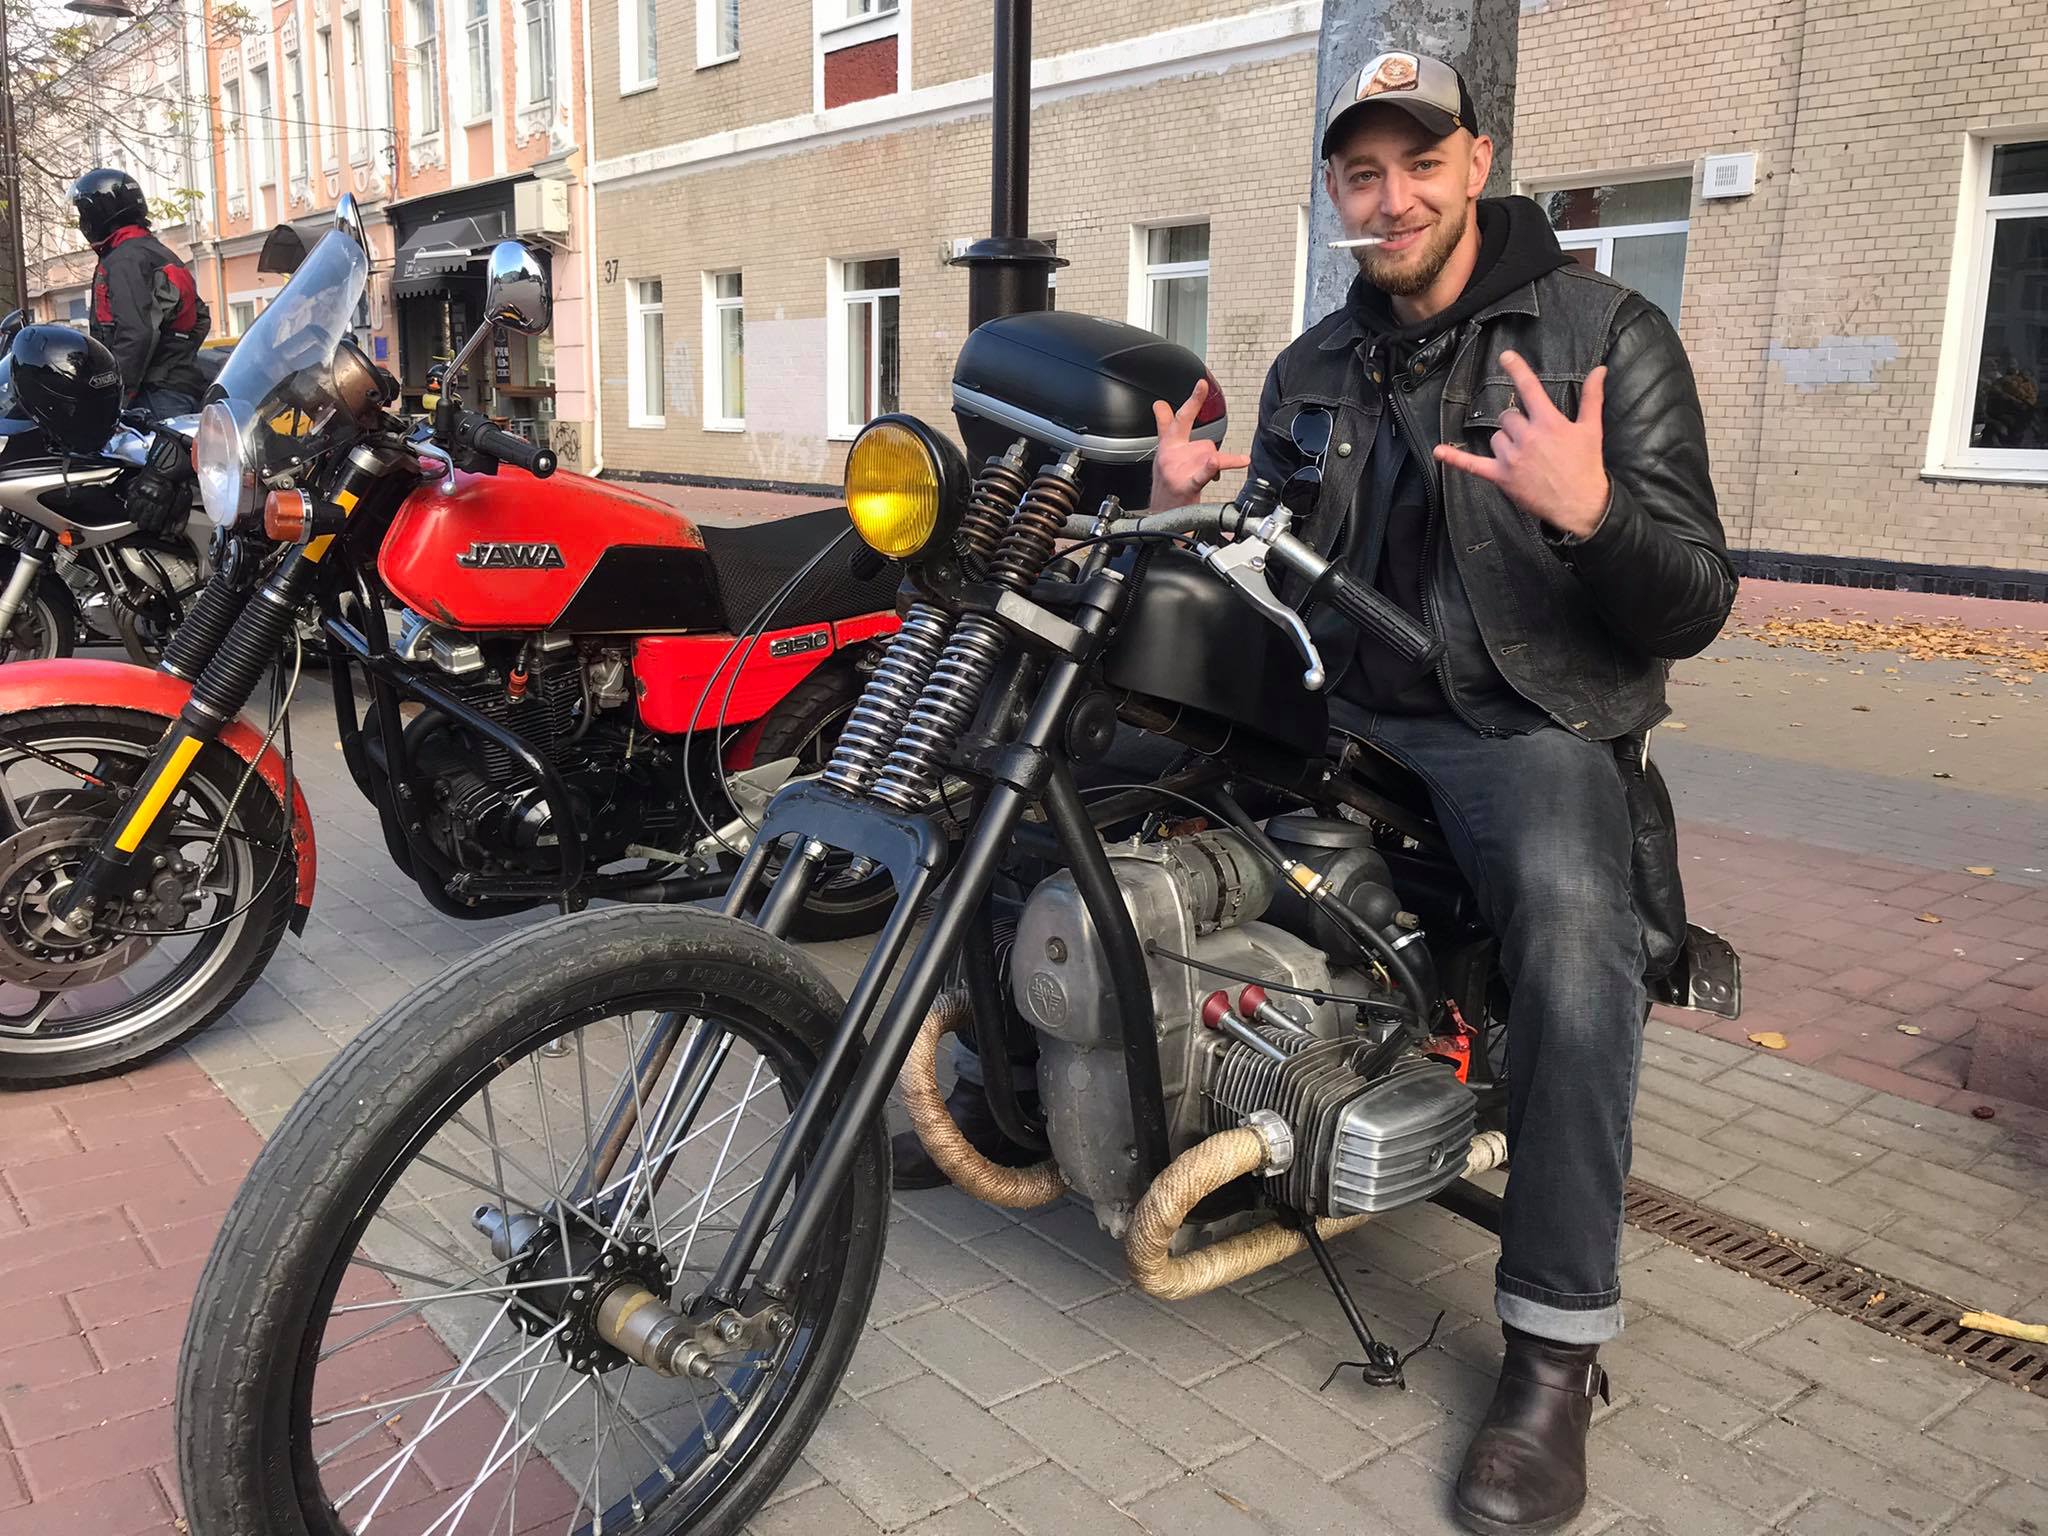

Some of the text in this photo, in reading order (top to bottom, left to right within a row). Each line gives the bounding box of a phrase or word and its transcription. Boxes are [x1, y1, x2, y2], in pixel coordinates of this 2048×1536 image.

[605, 259, 619, 284] 37
[456, 542, 567, 570] JAWA
[770, 631, 828, 657] 350
